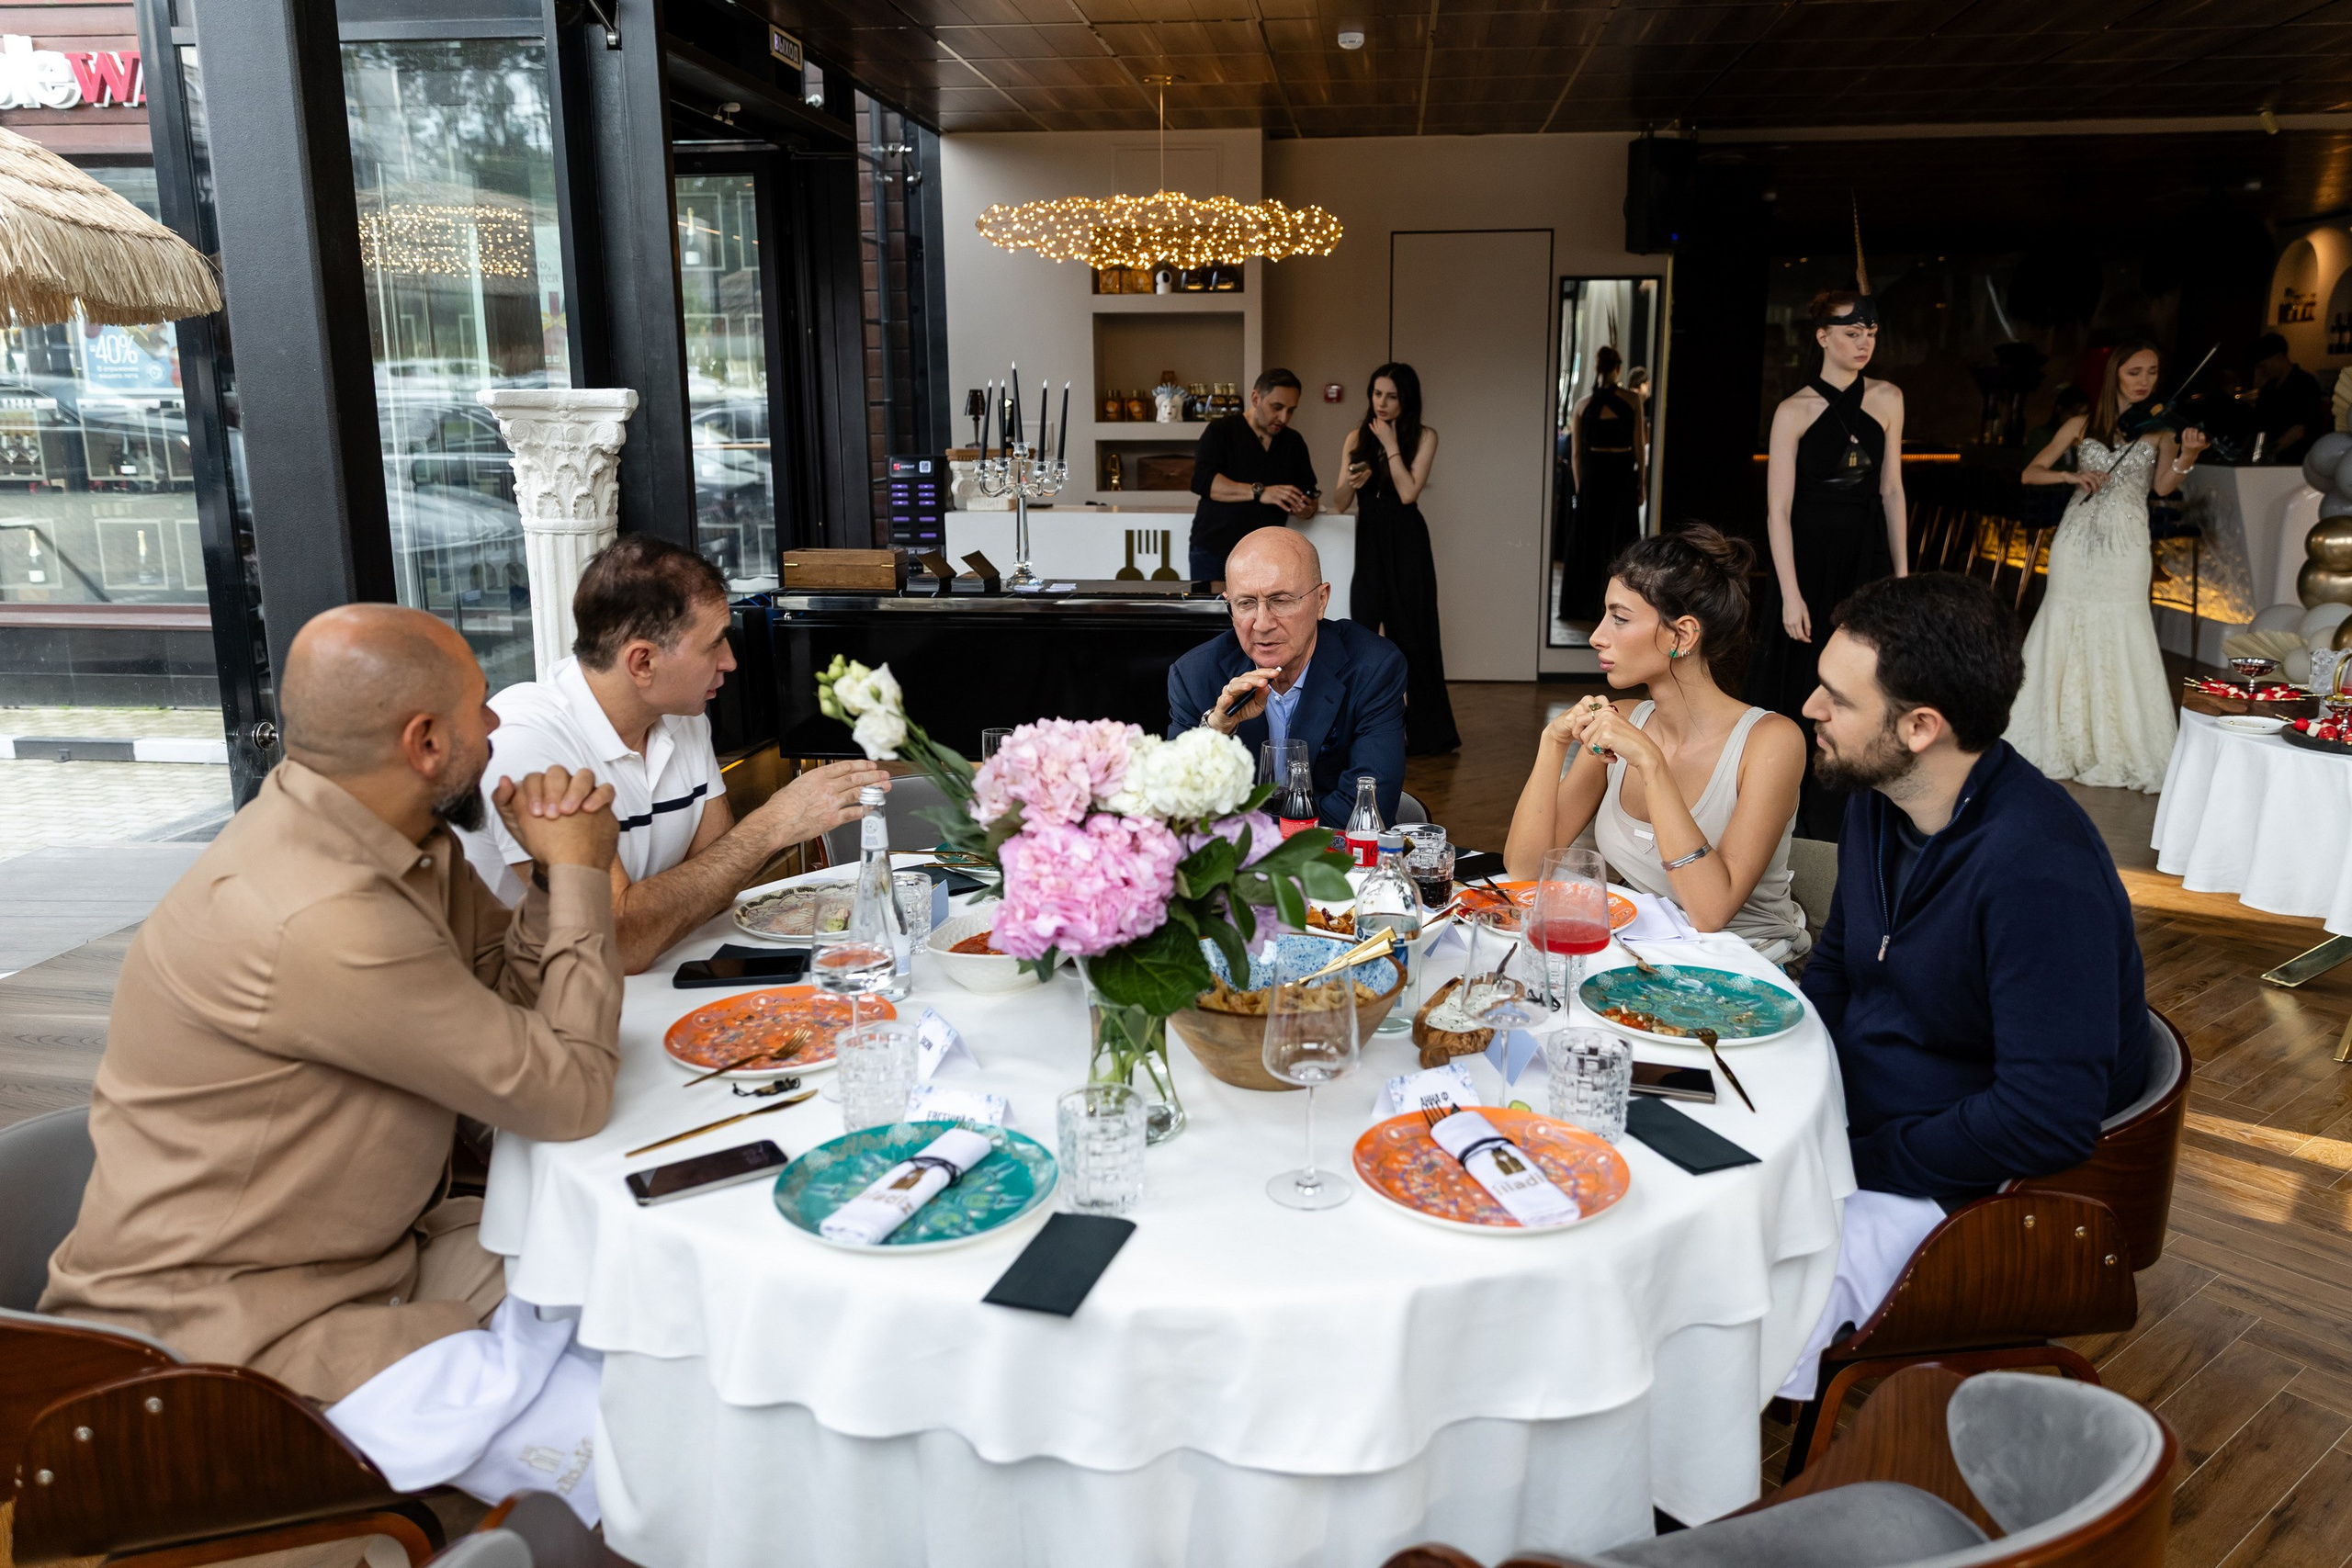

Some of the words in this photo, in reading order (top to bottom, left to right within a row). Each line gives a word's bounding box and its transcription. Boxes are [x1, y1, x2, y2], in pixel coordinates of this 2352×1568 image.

[774, 33, 798, 63] ВЫХОД
[90, 334, 139, 365] -40%
[1420, 1093, 1441, 1106] АННА
